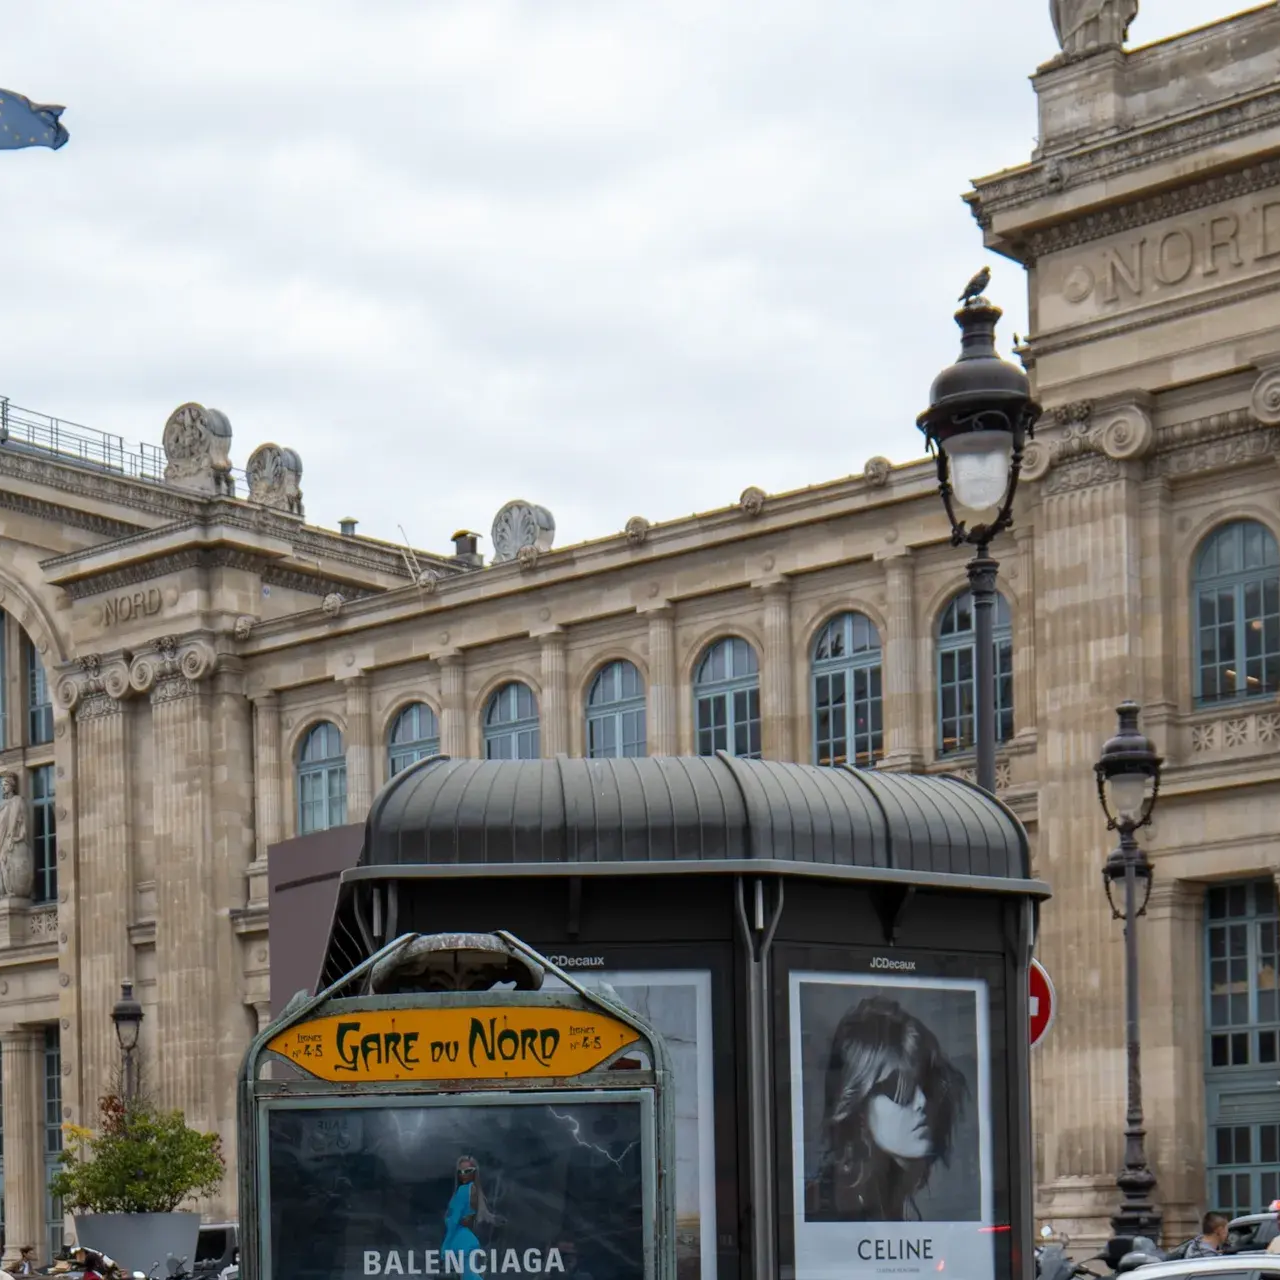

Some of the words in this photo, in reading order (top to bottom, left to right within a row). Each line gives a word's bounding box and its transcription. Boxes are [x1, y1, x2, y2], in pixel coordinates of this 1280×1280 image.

[104, 587, 163, 627] NORD
[546, 955, 605, 967] CDecaux
[869, 956, 916, 970] JCDecaux
[857, 1239, 934, 1261] CELINE
[363, 1247, 566, 1276] BALENCIAGA
